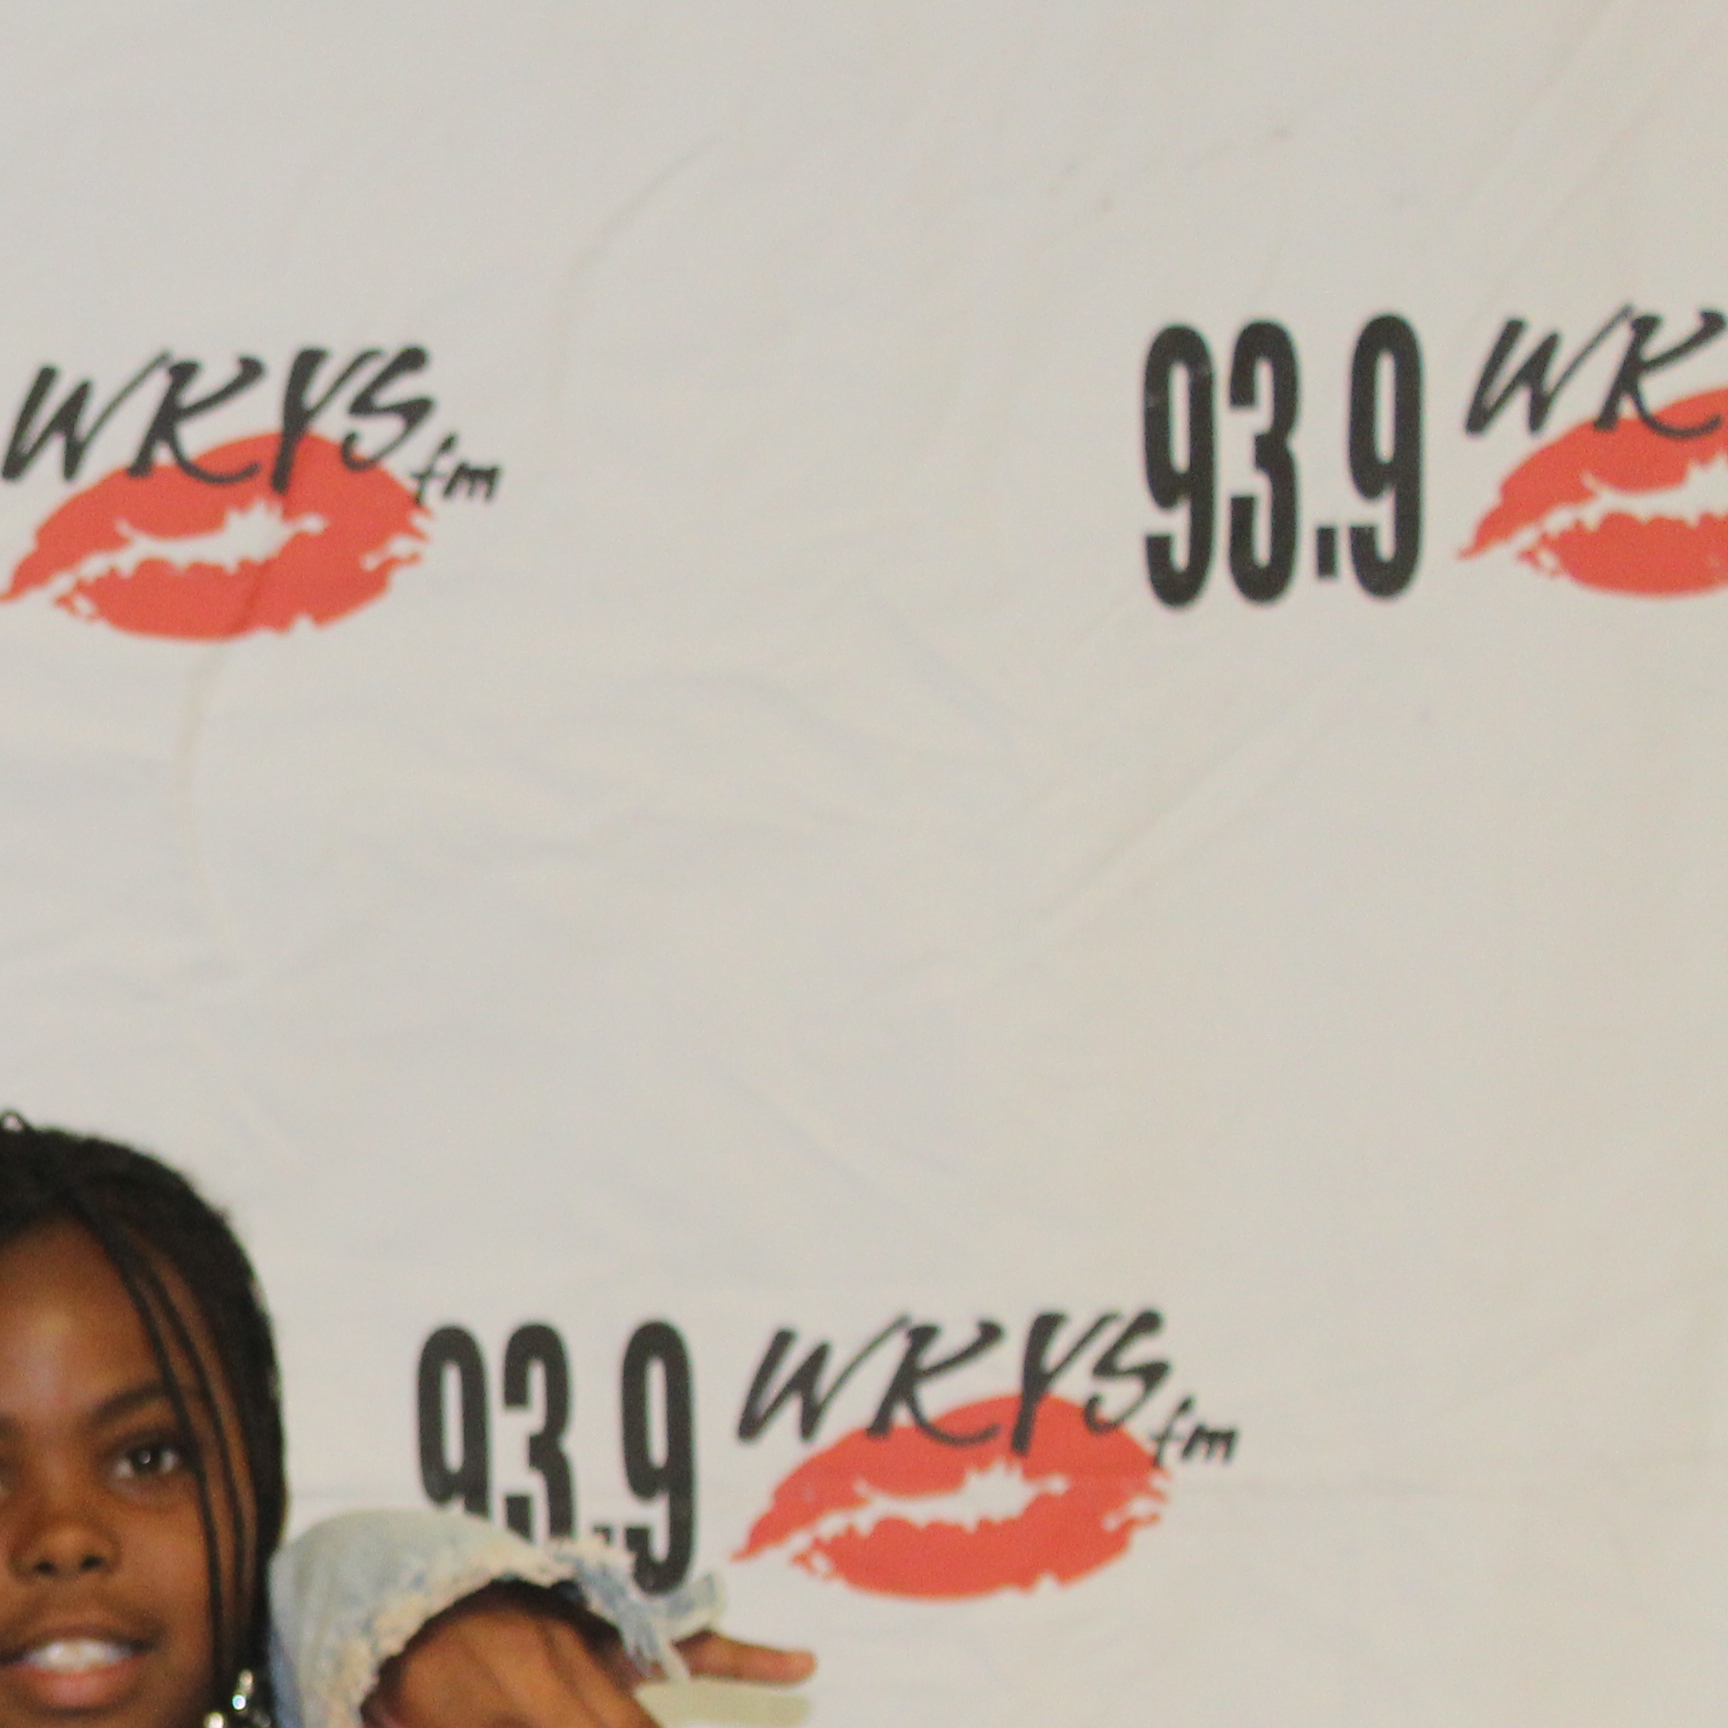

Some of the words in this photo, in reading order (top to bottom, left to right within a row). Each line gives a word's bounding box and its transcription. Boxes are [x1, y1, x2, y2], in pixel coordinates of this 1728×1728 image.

[0, 346, 435, 495] WKYS
[1142, 313, 1424, 610] 93.9
[1464, 303, 1728, 440] WK
[736, 1309, 1170, 1454] WKYS
